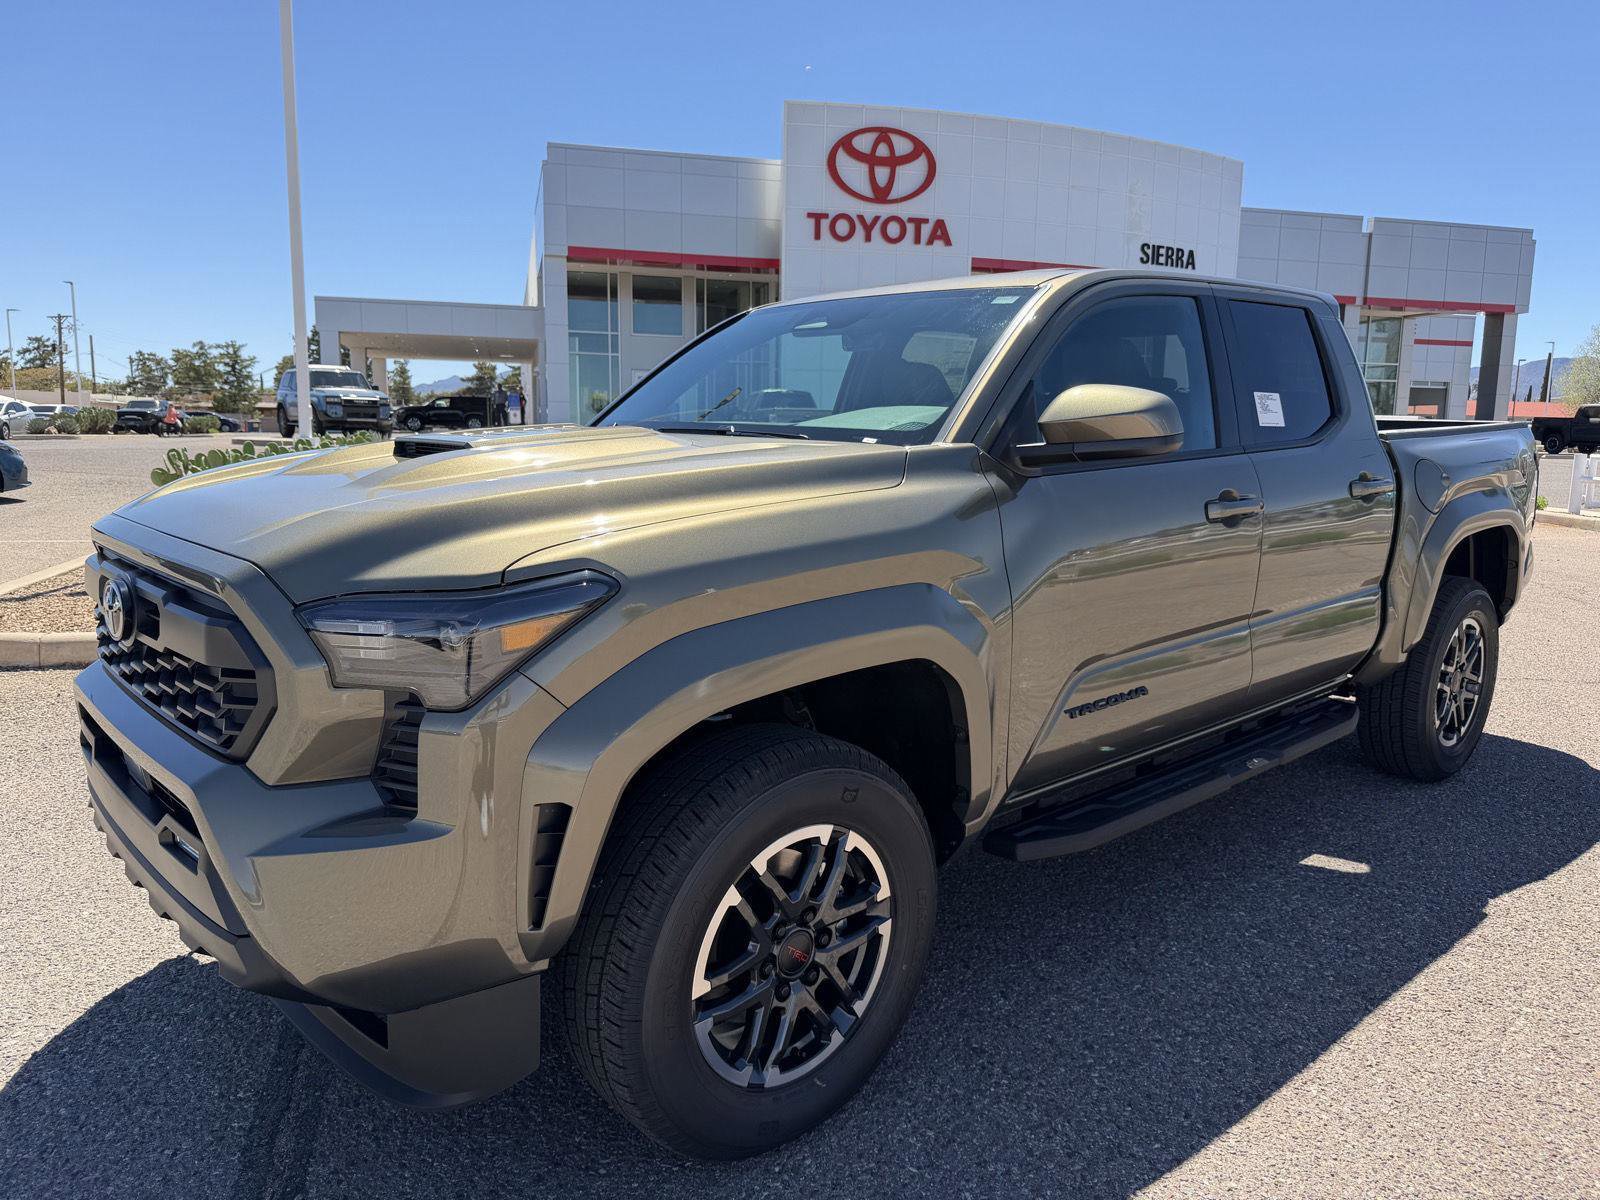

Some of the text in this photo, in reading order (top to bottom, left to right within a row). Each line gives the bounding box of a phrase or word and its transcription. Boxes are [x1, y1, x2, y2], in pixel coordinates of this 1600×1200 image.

[807, 212, 952, 247] TOYOTA
[1139, 243, 1196, 270] SIERRA
[1064, 685, 1148, 719] TACOMA
